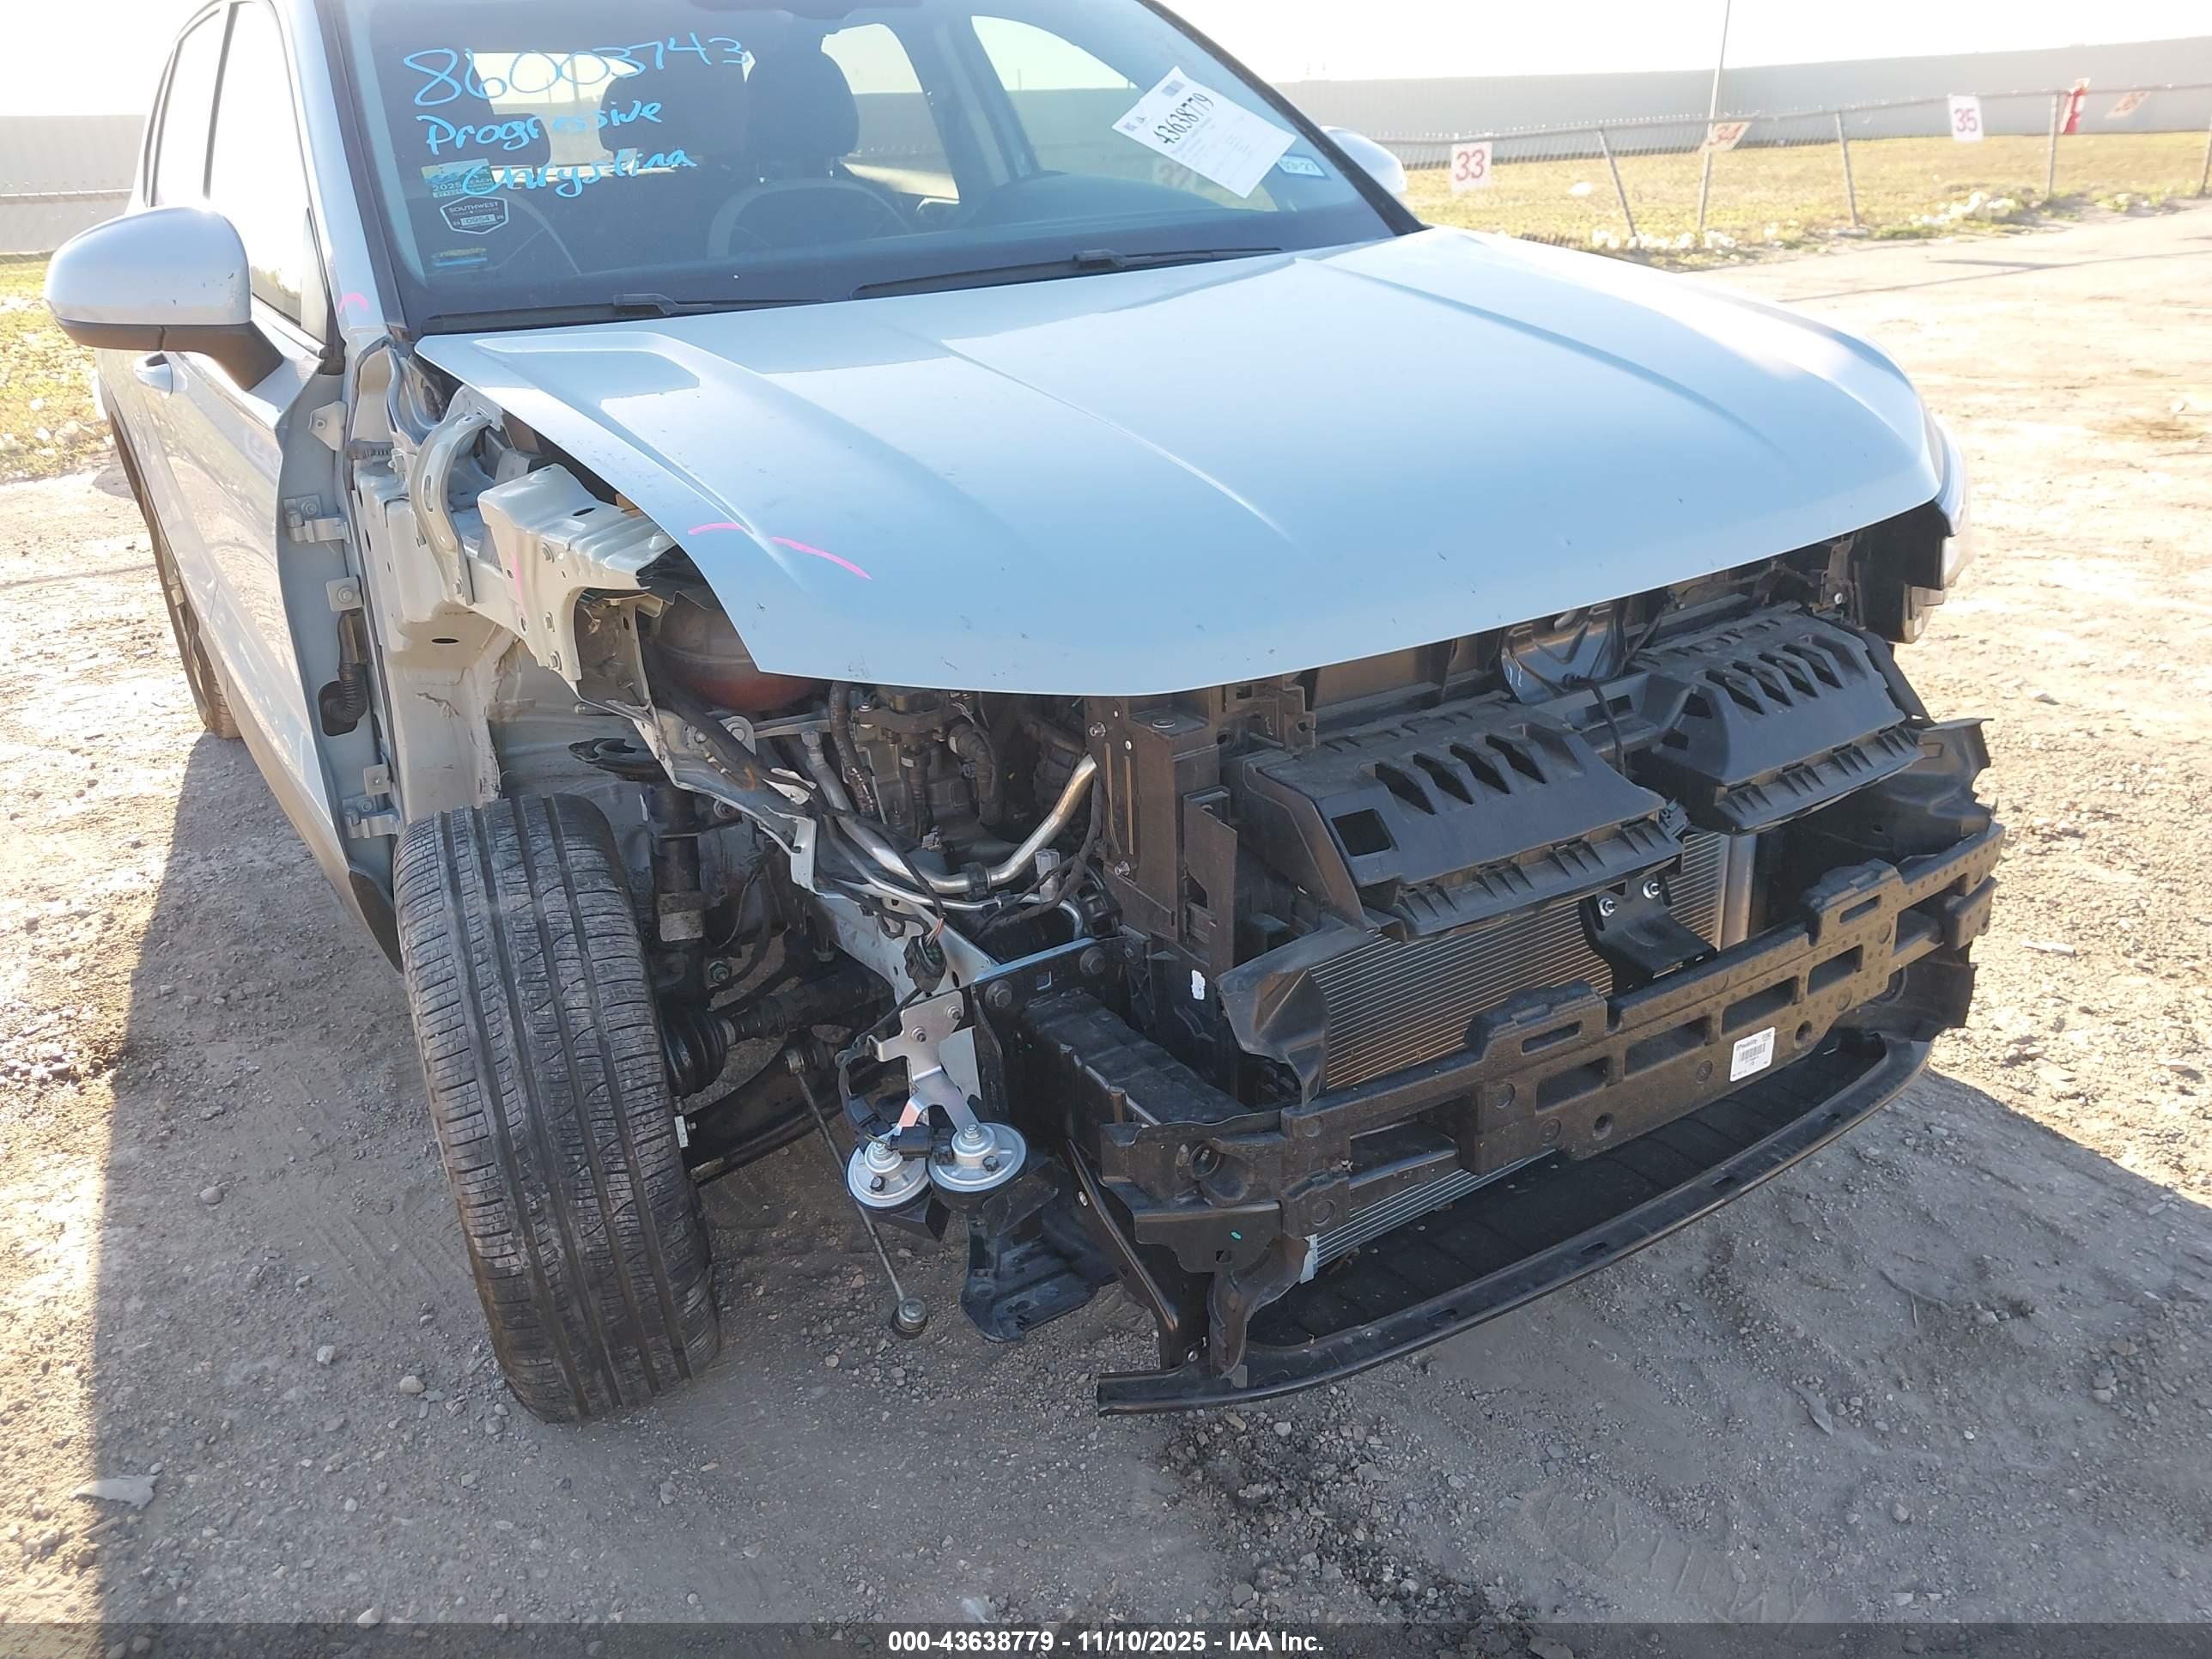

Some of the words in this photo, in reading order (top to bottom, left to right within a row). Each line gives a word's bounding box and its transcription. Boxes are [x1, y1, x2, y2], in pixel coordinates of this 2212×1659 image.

[404, 33, 750, 106] 86003743
[416, 100, 662, 155] Progressive
[1153, 92, 1215, 144] 43638779
[1954, 107, 1978, 132] 35
[1455, 149, 1485, 181] 33
[432, 181, 462, 192] 2025
[448, 201, 499, 213] SOUTHWEST
